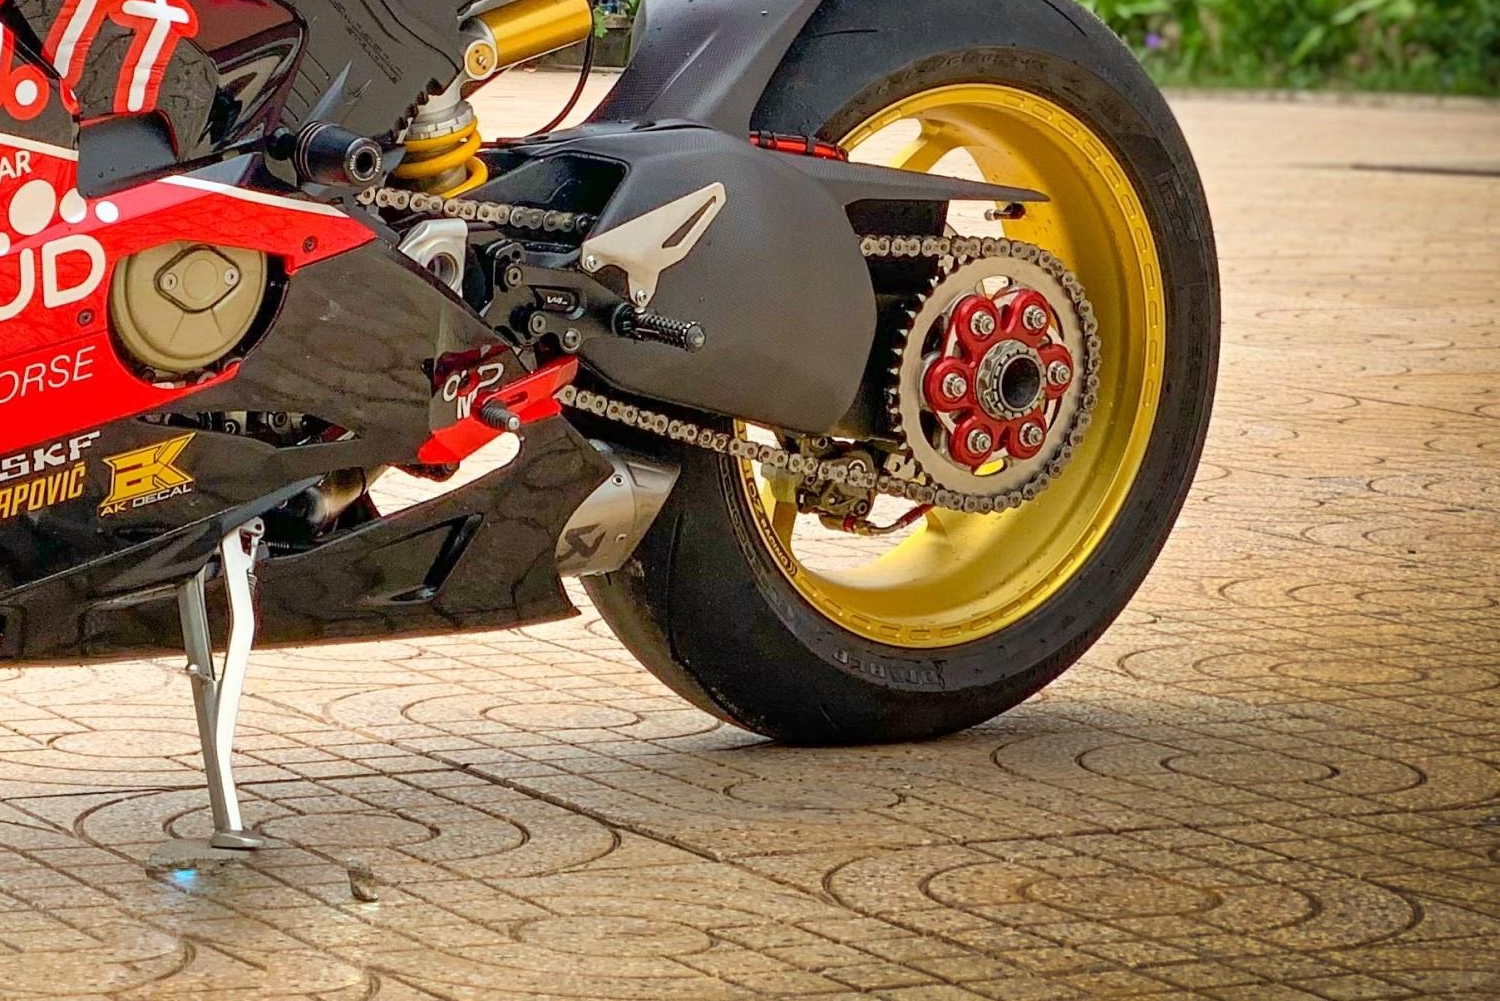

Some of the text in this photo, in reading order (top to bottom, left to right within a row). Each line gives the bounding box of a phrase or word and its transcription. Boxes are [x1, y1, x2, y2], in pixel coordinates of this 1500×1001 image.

[0, 430, 101, 482] SKF
[100, 484, 193, 517] AK DECAL
[760, 519, 789, 569] RACING
